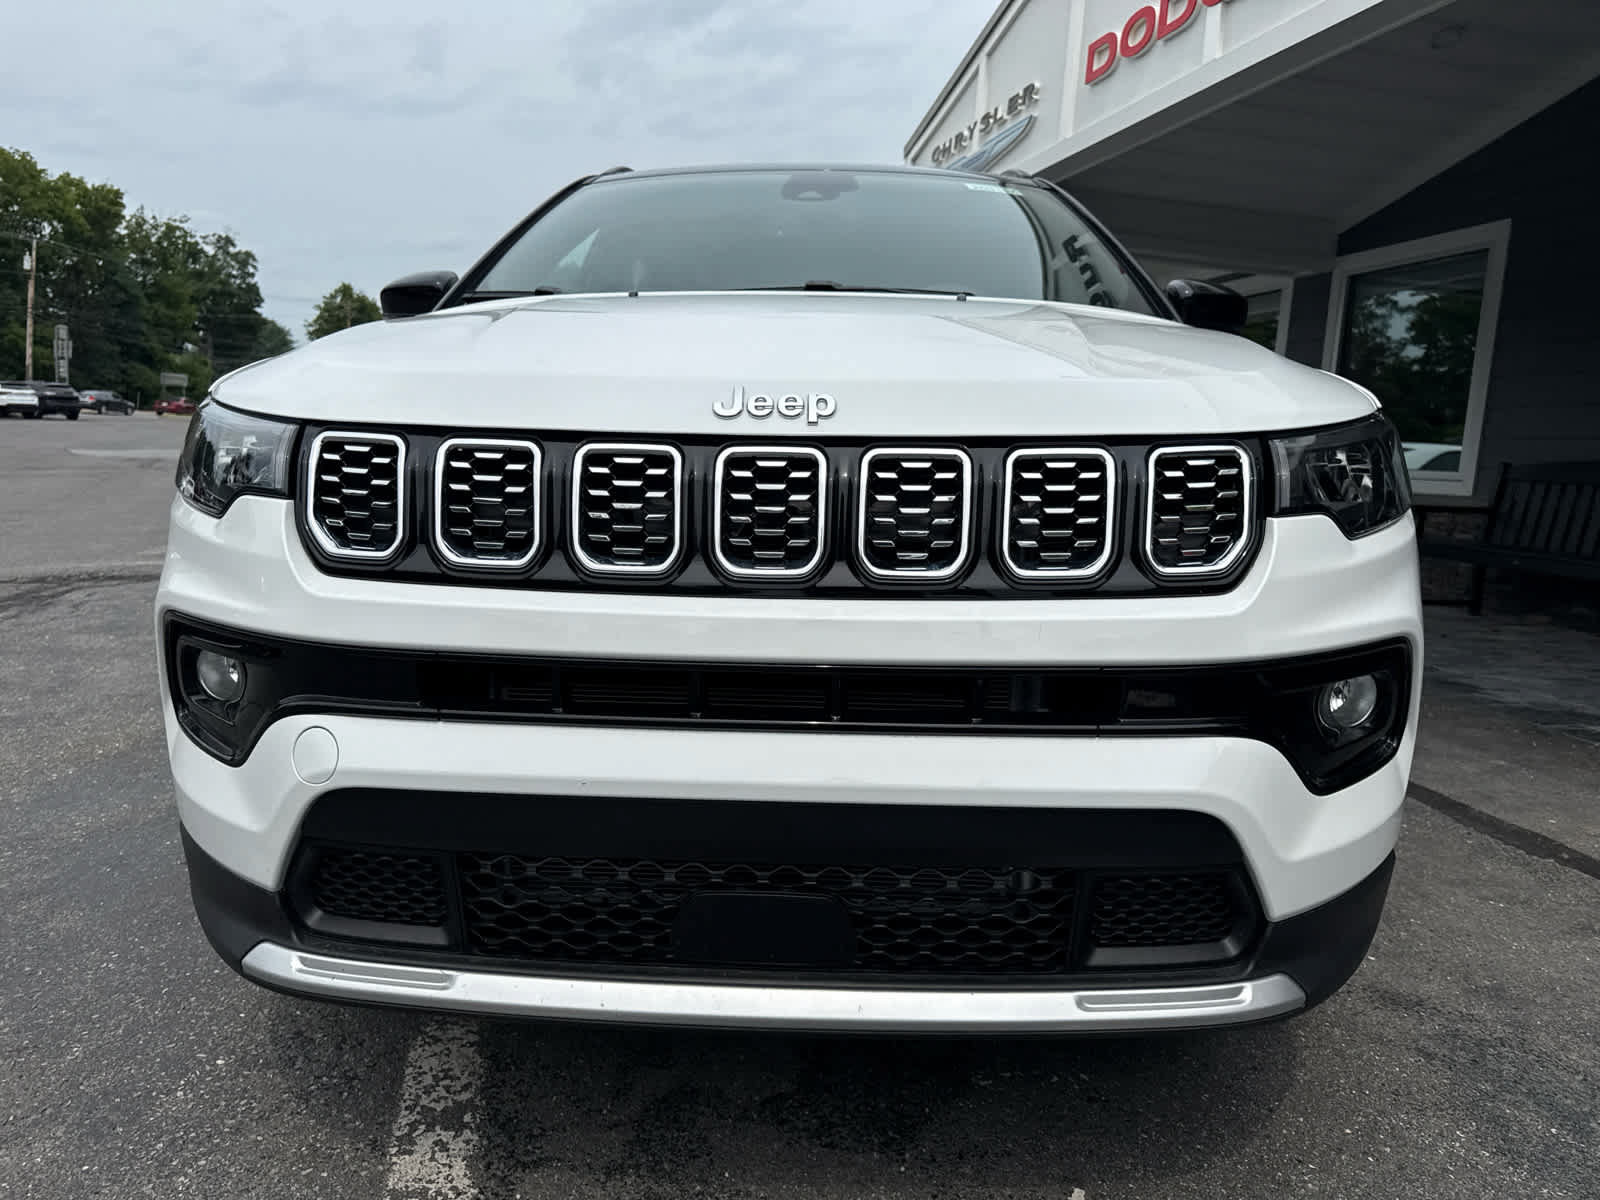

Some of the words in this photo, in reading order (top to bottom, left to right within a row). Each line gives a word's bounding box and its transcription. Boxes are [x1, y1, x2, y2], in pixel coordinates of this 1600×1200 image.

[1084, 0, 1225, 85] DOD
[932, 83, 1039, 165] CHRYSLER
[712, 384, 837, 426] Jeep
